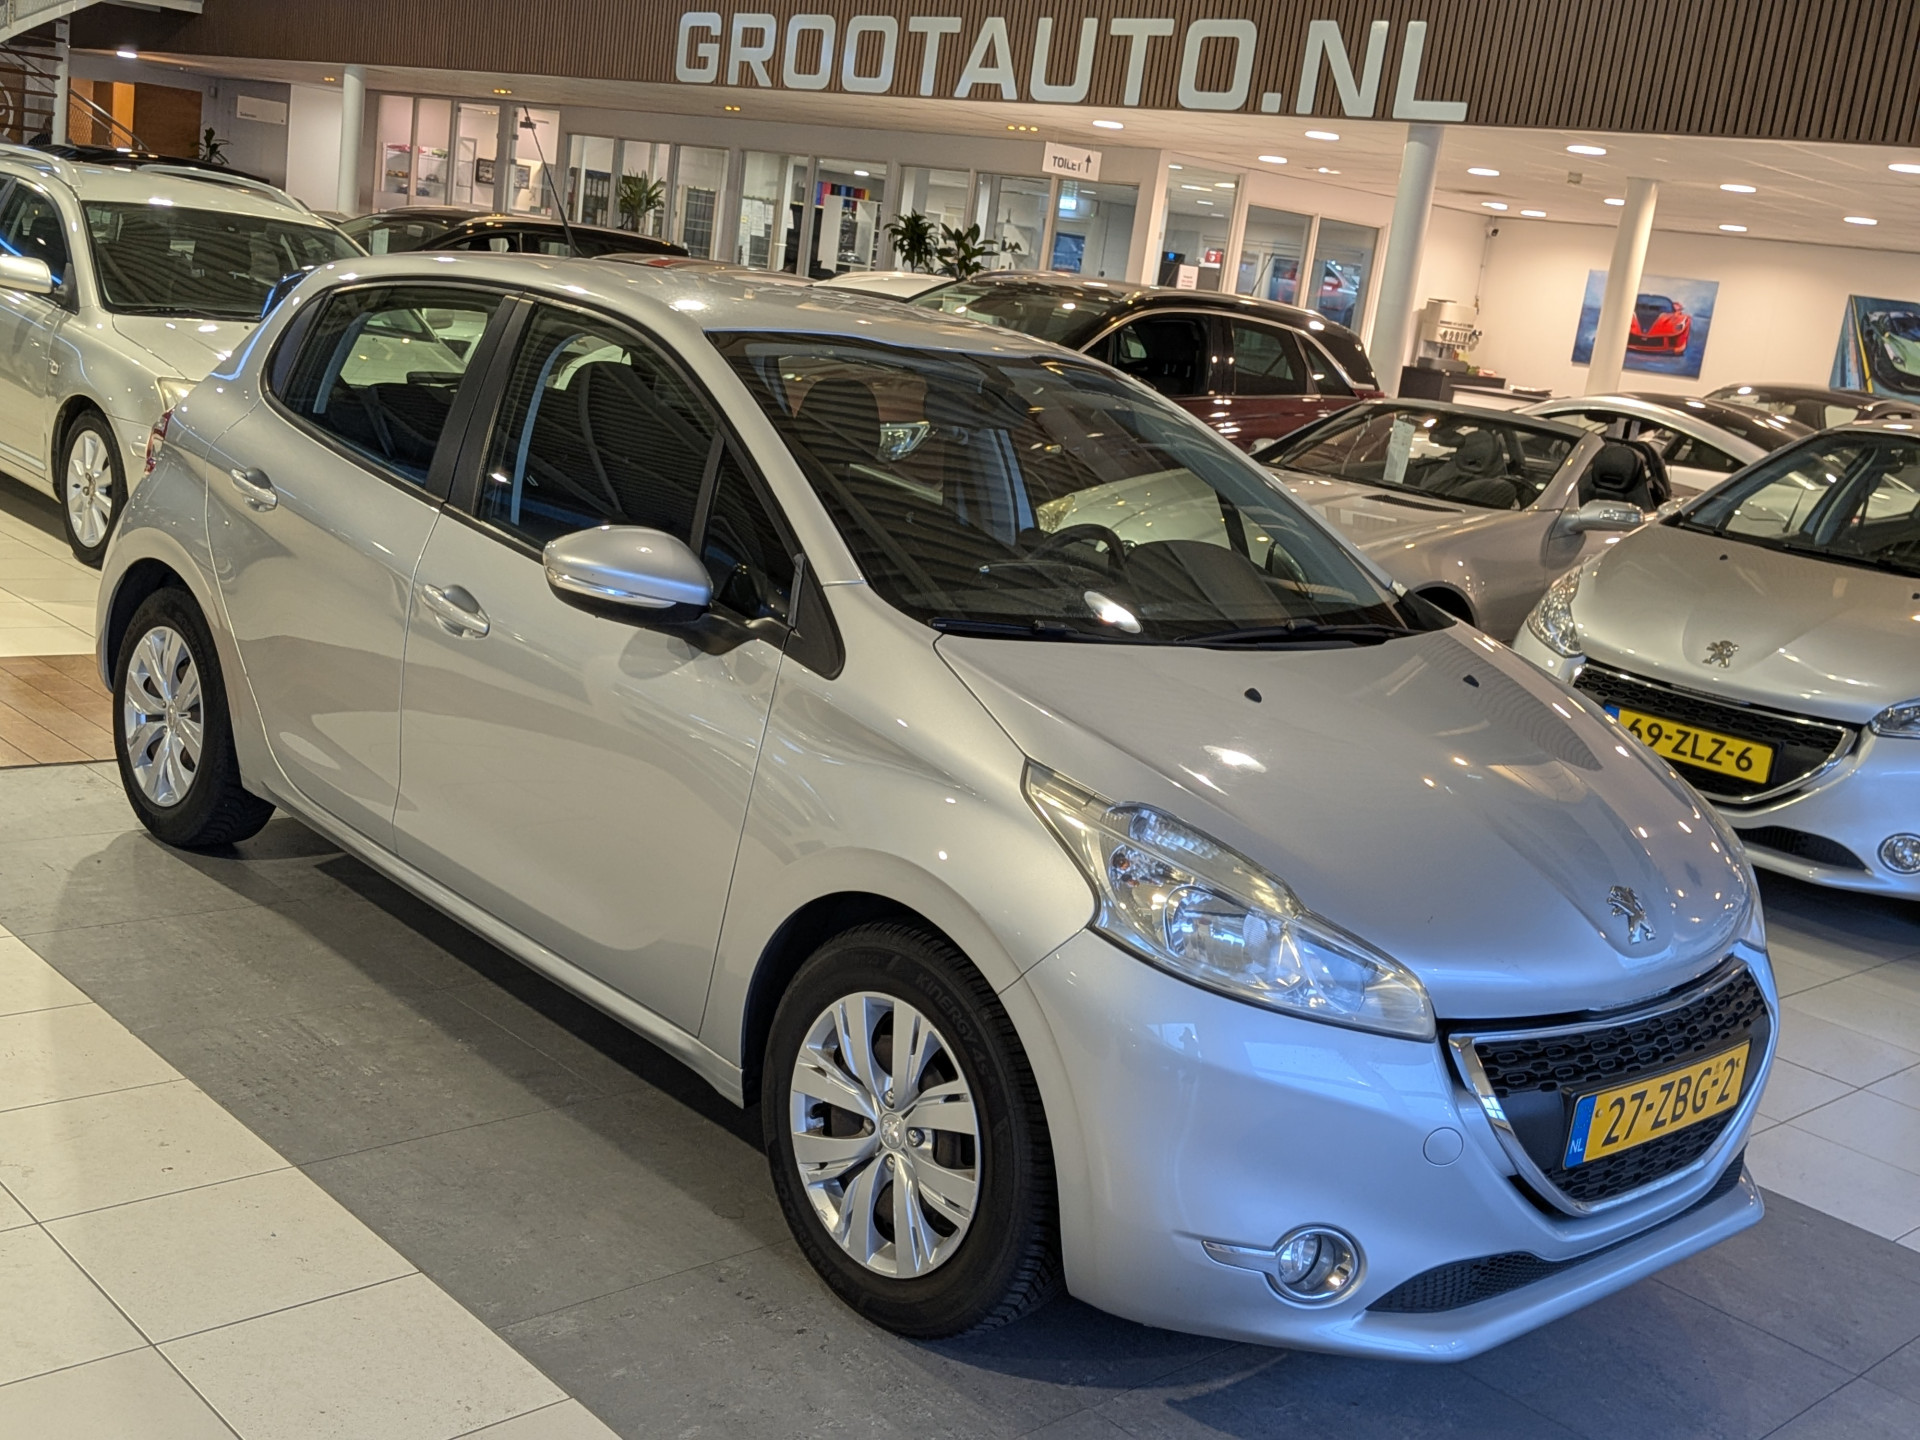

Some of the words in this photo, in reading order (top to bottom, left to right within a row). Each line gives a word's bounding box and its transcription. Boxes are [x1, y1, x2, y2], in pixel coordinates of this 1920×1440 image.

[674, 11, 1468, 122] GROOTAUTO.NL
[1052, 155, 1082, 172] TOILET
[1601, 1057, 1735, 1148] 27-ZBG-2
